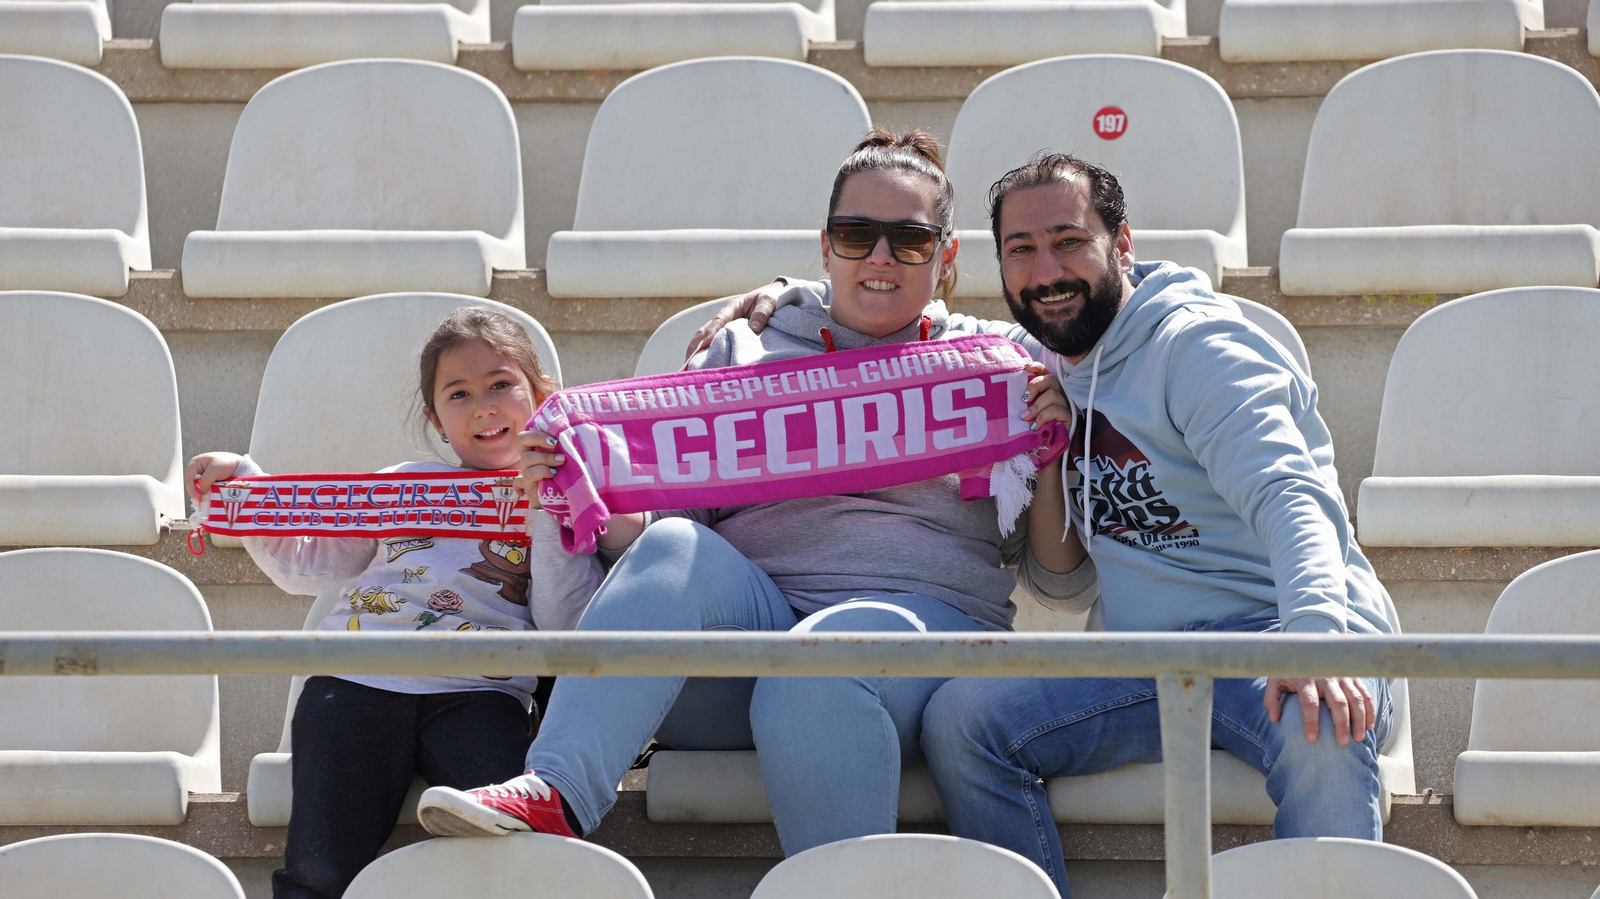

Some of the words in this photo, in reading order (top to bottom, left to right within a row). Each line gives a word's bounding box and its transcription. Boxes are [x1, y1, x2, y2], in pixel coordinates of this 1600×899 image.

[1096, 113, 1125, 133] 197
[559, 384, 701, 414] HICIERON
[704, 366, 857, 403] ESPECIAL,
[858, 350, 974, 384] GUAPA,
[257, 481, 485, 509] ALGECIRAS
[252, 511, 324, 528] CLUB
[334, 512, 369, 528] DE
[1174, 539, 1200, 549] 1990
